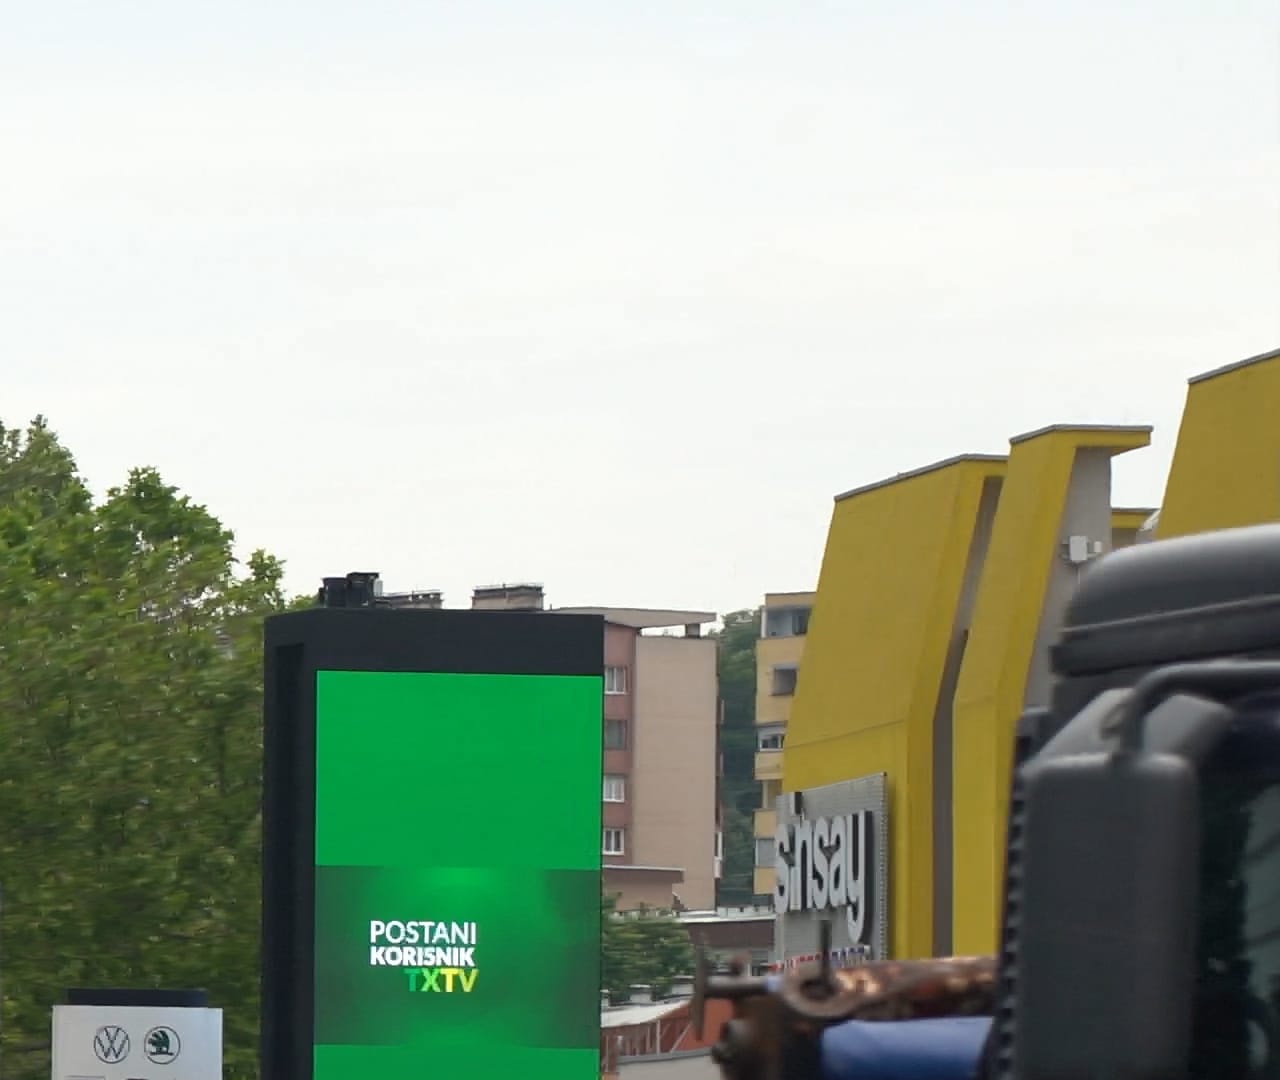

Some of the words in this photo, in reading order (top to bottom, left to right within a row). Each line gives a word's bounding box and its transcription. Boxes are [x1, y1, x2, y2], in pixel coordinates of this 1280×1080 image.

[774, 792, 867, 943] sinsay
[370, 920, 477, 945] POSTANI
[370, 946, 476, 967] KORISNIK
[404, 967, 480, 993] TXTV
